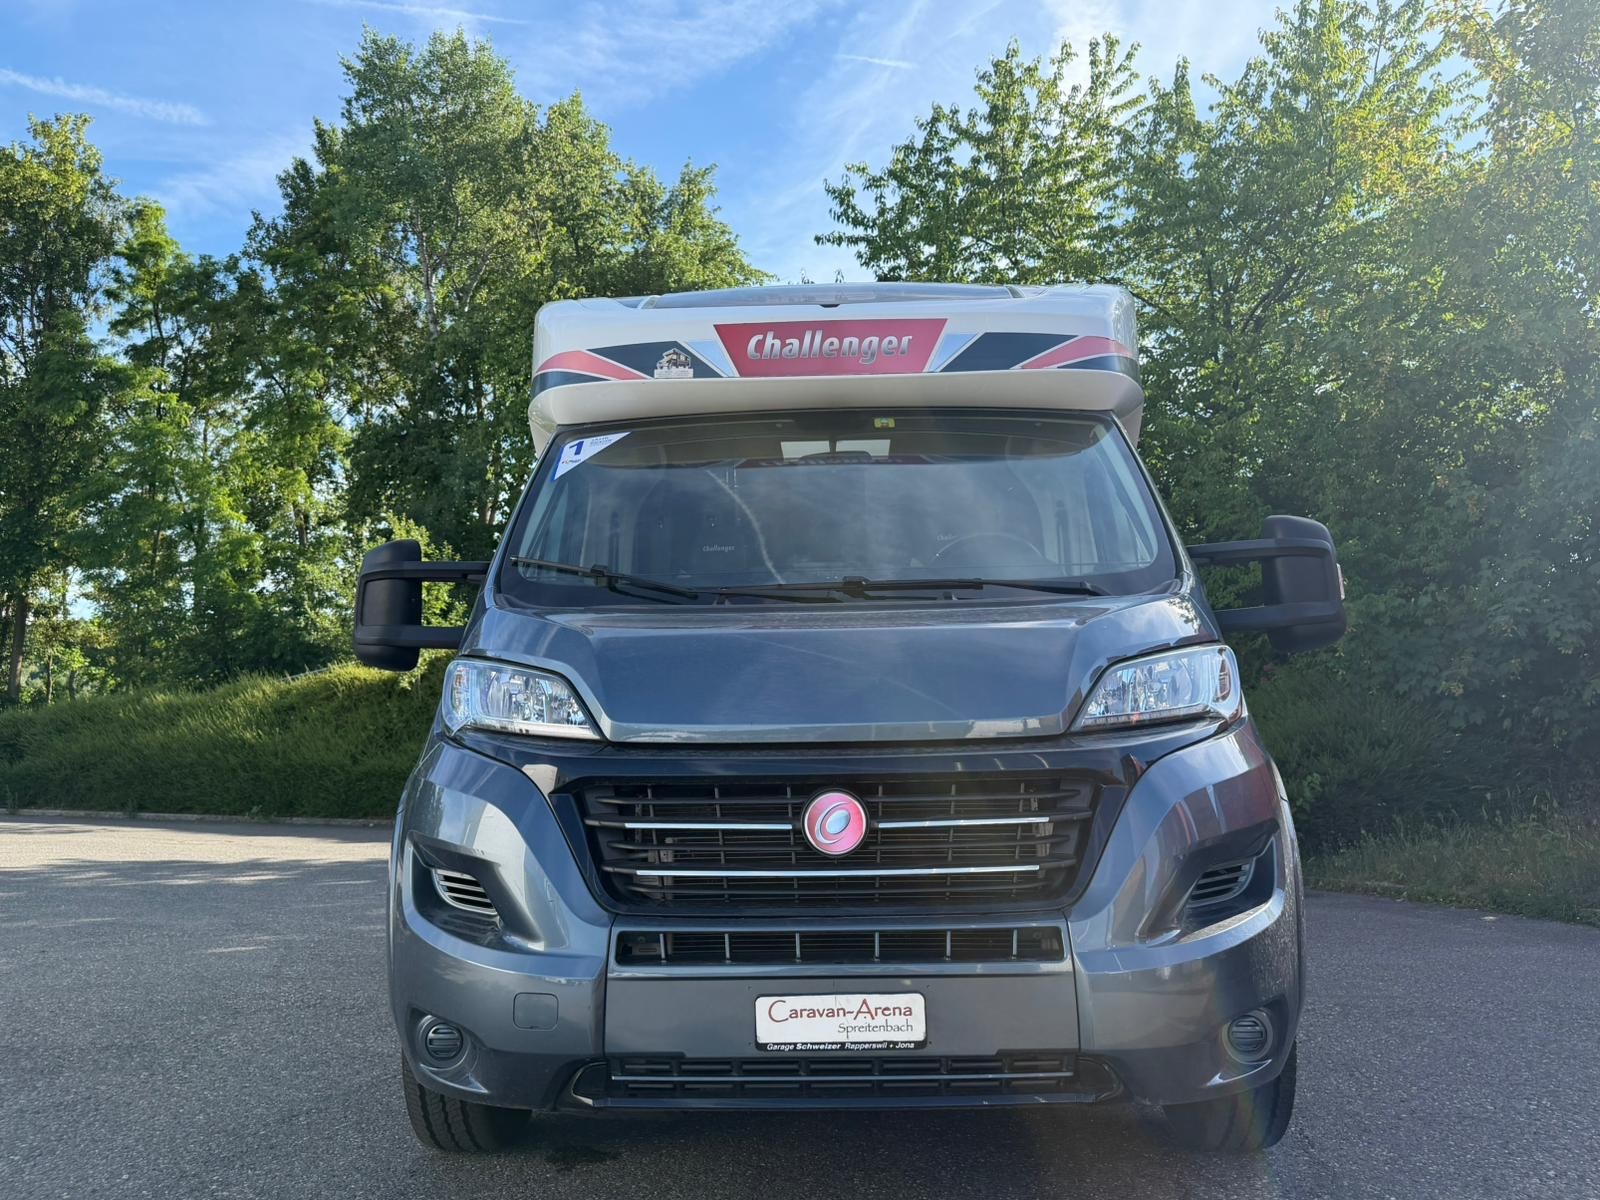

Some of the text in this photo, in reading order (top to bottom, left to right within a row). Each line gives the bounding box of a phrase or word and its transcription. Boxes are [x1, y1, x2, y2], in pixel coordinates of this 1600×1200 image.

[747, 329, 913, 365] Challenger
[568, 440, 585, 456] 1
[768, 998, 913, 1023] Caravan-Arena
[837, 1019, 914, 1039] Spreitenbach
[766, 1043, 795, 1052] Garage
[796, 1042, 841, 1051] Schweizer
[844, 1042, 888, 1051] Rapperswil
[895, 1042, 915, 1050] Jona
